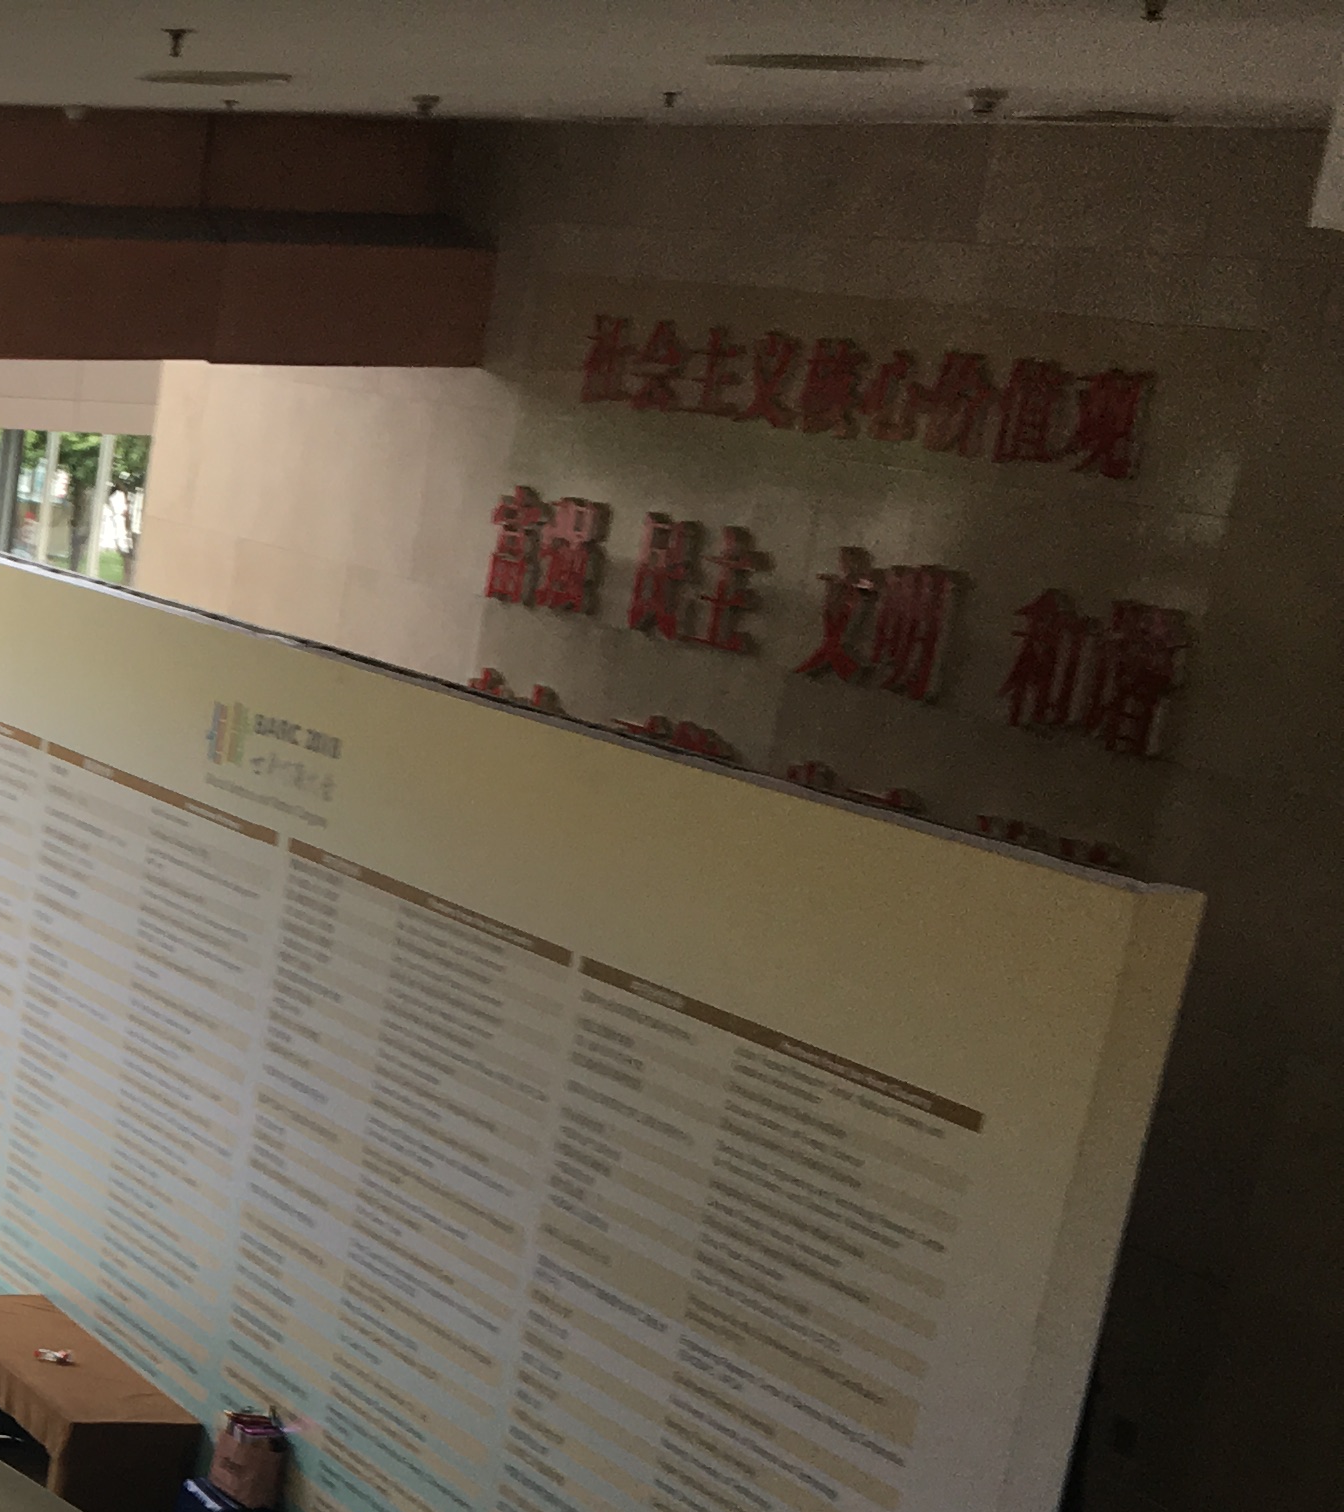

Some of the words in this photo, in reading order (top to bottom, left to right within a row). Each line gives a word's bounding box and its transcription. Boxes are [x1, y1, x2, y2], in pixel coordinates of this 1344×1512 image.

[580, 312, 1157, 479] 社会主义核心价值观
[485, 486, 610, 614] 富强
[629, 510, 764, 653] 民主
[793, 546, 964, 701] 文明
[998, 588, 1192, 757] 和谐
